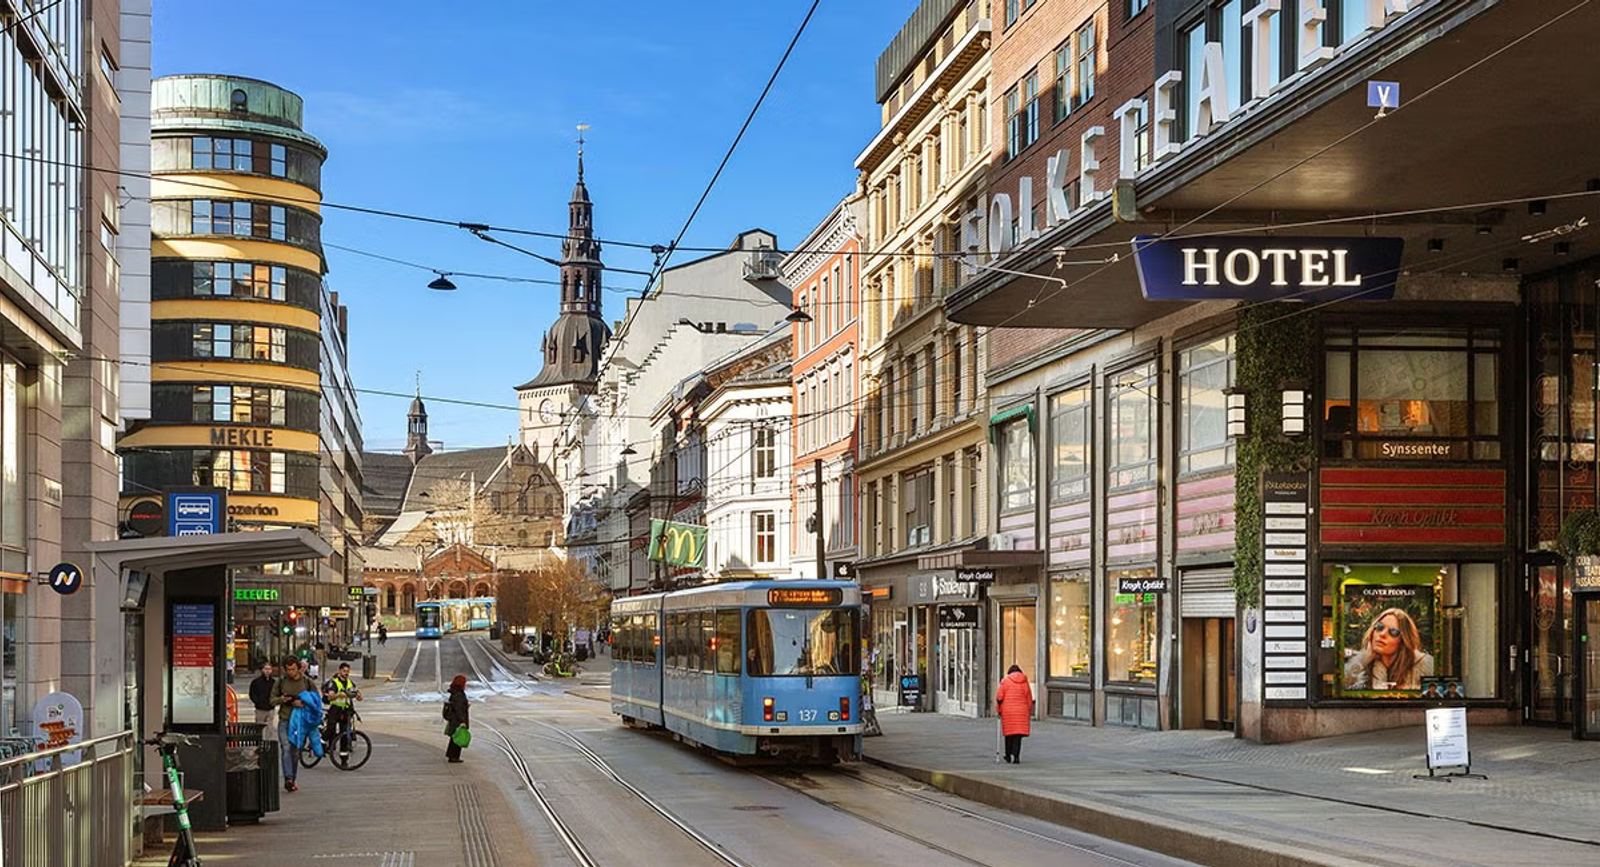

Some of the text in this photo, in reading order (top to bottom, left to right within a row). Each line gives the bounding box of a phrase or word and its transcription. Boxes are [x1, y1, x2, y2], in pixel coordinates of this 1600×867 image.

[1181, 248, 1362, 287] HOTEL
[211, 427, 274, 447] MEKLE
[1382, 442, 1450, 457] Synssenter
[1122, 580, 1165, 592] Krogh Optikk
[1363, 588, 1416, 596] OLIVER PEOPLES
[798, 709, 818, 721] 137
